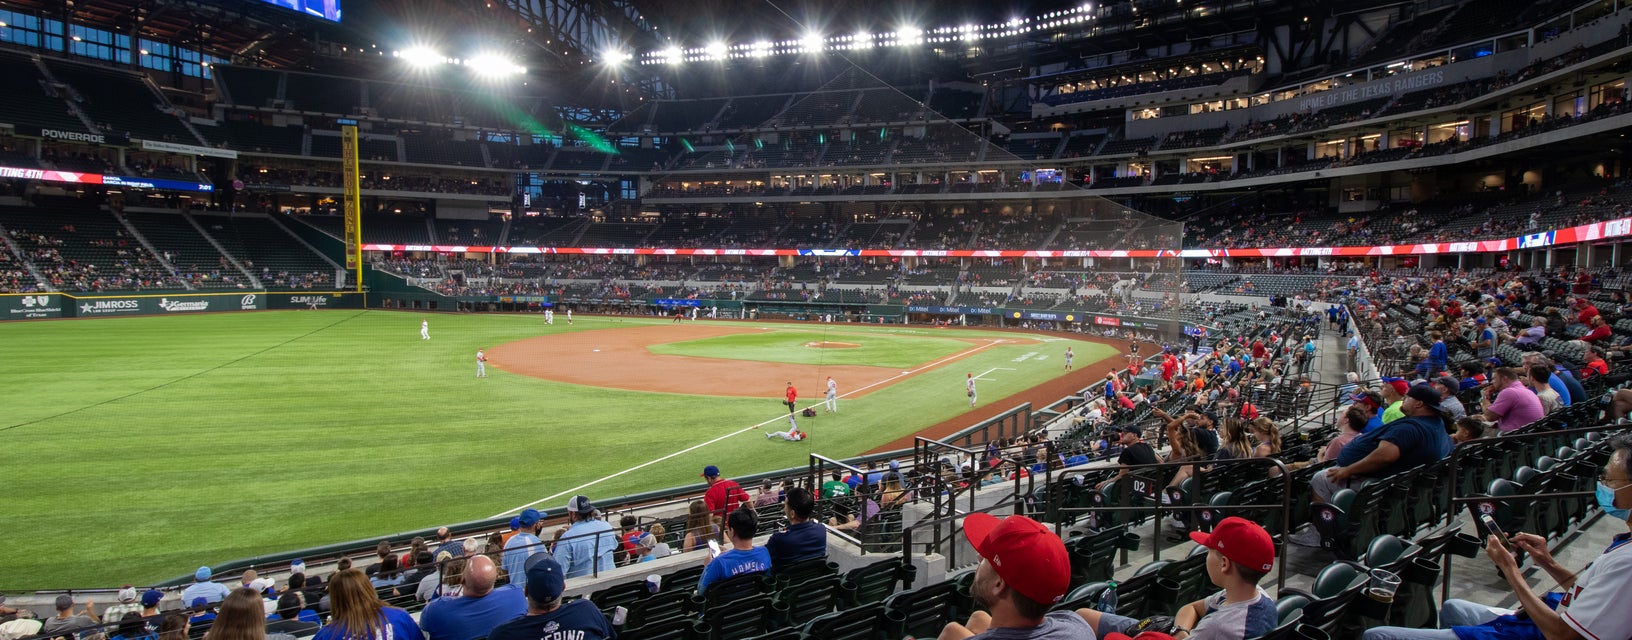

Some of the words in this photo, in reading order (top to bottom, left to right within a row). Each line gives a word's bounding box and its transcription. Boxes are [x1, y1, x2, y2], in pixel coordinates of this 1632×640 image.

[1328, 92, 1338, 106] OF
[1342, 88, 1358, 102] THE
[1362, 83, 1391, 98] TEXAS
[1394, 70, 1444, 92] RANGERS
[41, 128, 105, 143] POWERADE
[24, 169, 44, 179] 4TH
[1134, 480, 1146, 493] 02
[541, 630, 585, 640] ERINO
